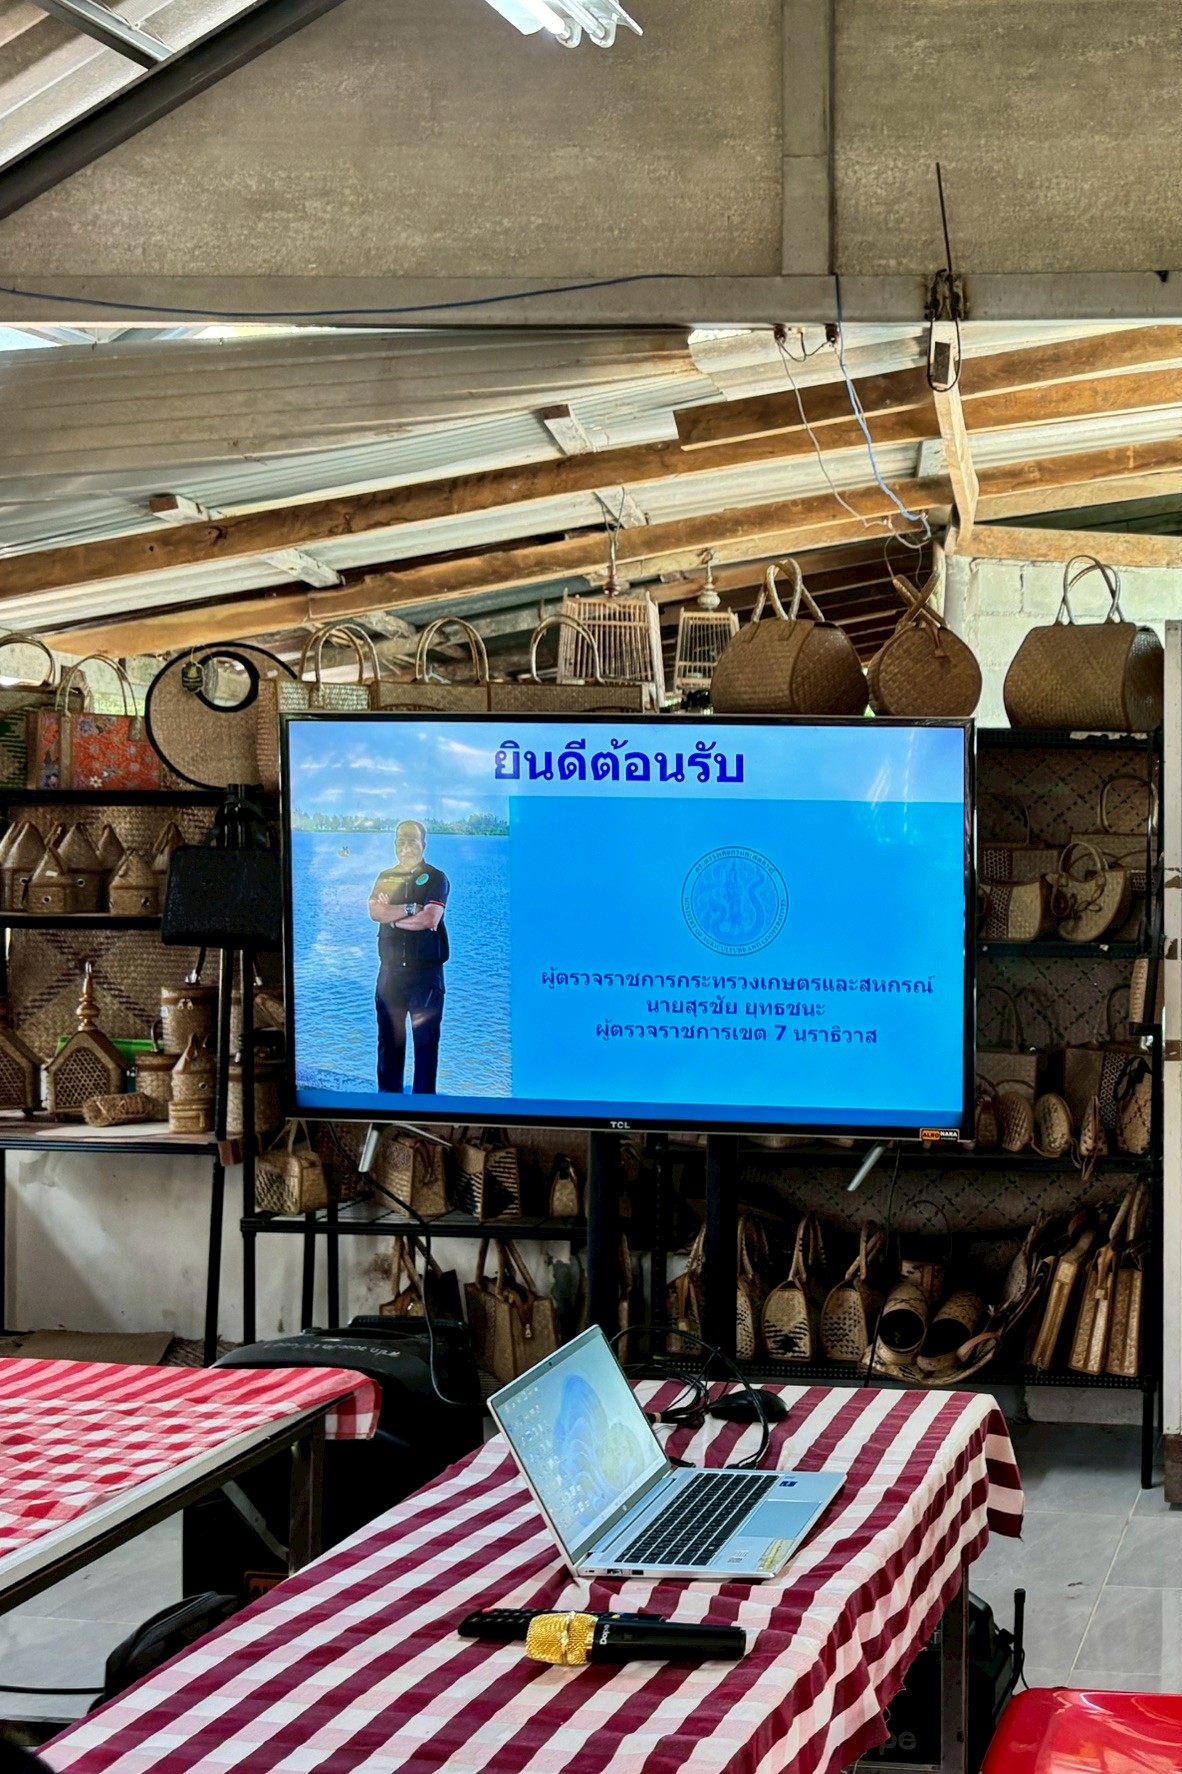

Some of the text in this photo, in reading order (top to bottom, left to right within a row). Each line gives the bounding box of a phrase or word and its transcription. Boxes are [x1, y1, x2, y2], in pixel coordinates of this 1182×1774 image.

[494, 738, 744, 783] ยินดีต้อนรับ
[541, 966, 936, 994] ผู้ตรวจราชการกระทรวงเกษตรและสหกรณ์
[646, 995, 826, 1019] นายสุรชัย ยุทธชนะ
[596, 1018, 877, 1043] ผู้ตรวจราชการเขต 7 นราธิวาส
[610, 1121, 630, 1129] TCL
[879, 1731, 916, 1755] pe
